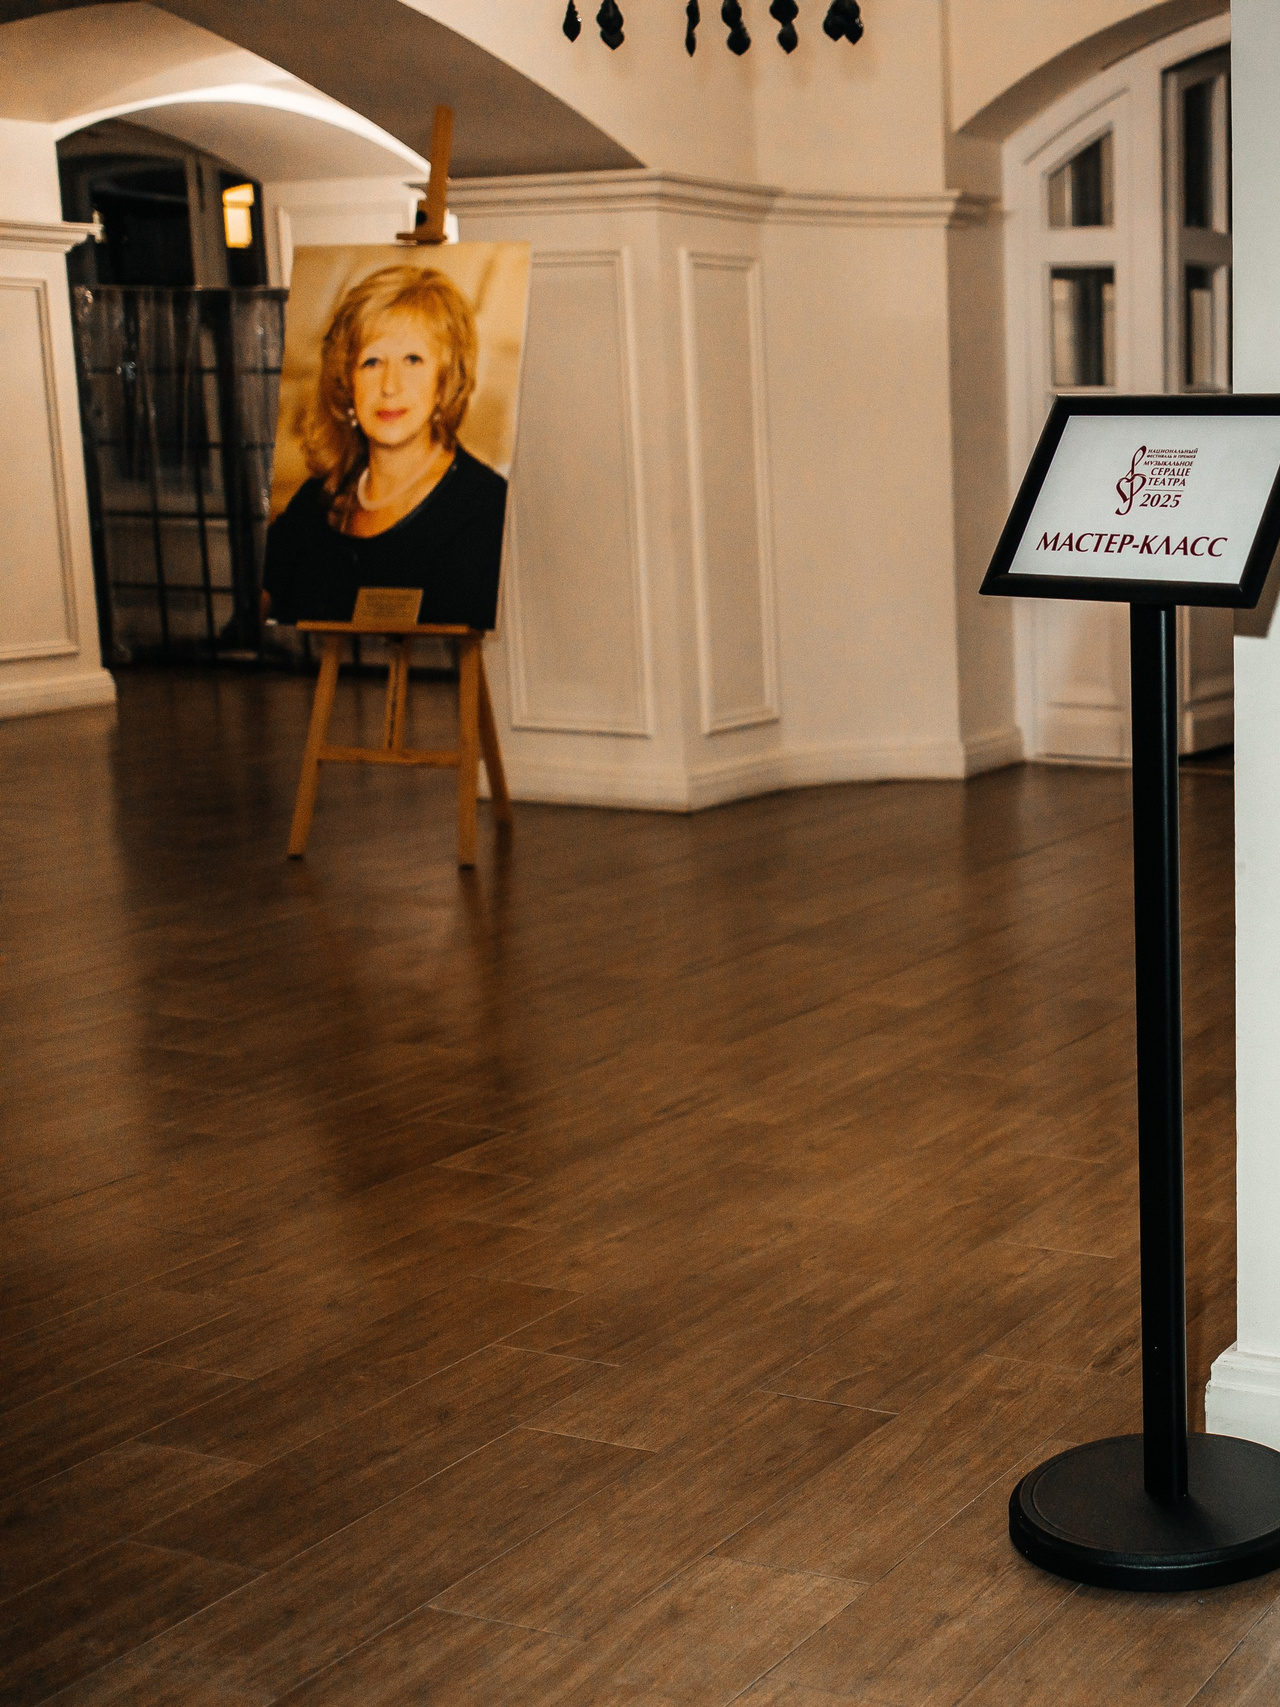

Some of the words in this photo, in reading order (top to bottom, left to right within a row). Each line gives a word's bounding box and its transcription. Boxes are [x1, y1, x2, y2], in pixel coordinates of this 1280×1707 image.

[1150, 467, 1191, 477] СЕРДЦЕ
[1147, 477, 1186, 487] ТЕАТРА
[1139, 493, 1182, 508] 2025
[1035, 531, 1228, 557] МАСТЕР-КЛАСС
